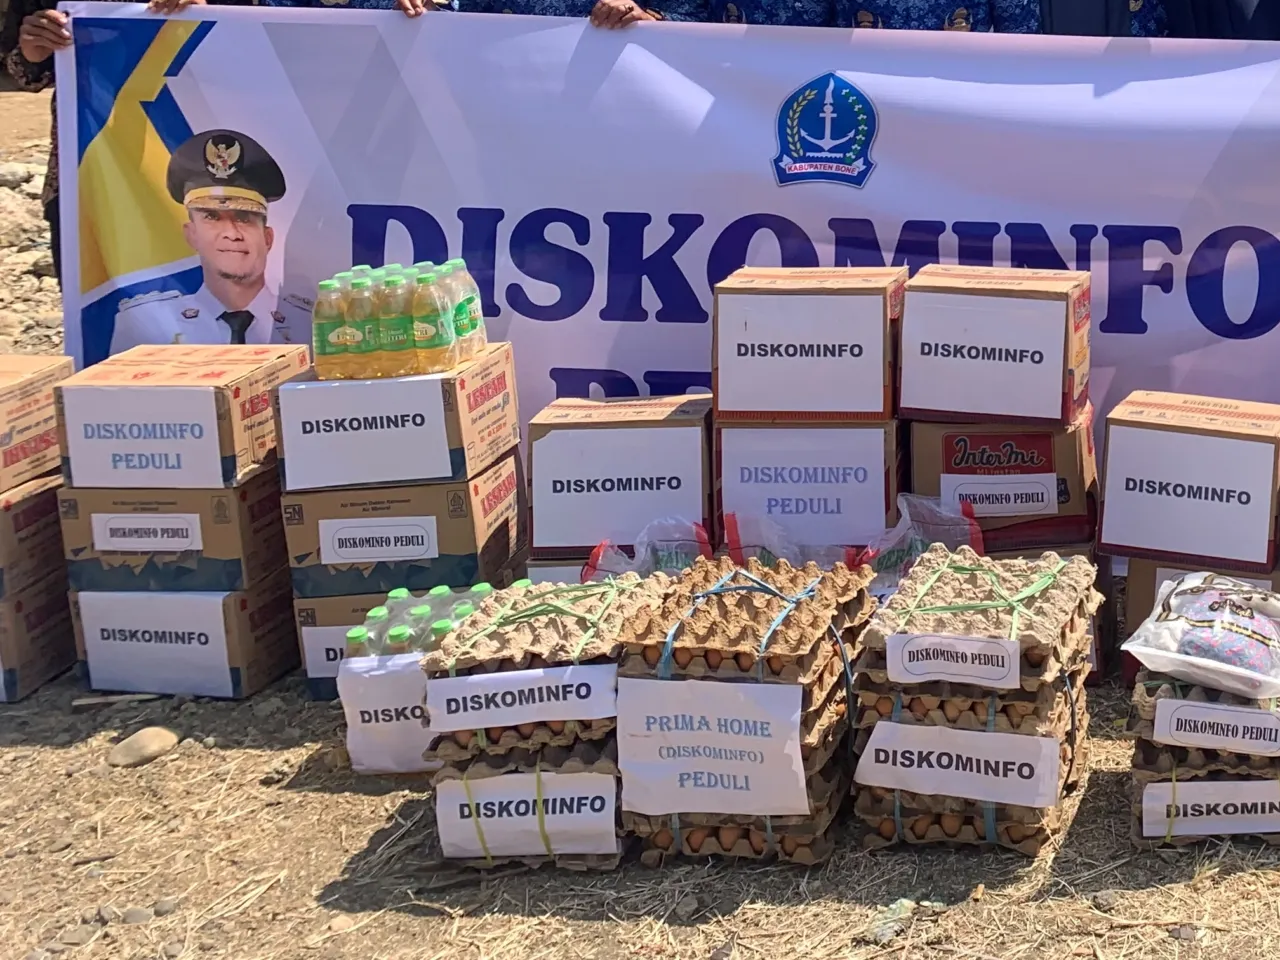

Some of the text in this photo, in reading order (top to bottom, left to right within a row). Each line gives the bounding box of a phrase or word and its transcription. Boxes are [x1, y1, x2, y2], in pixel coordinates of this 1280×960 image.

[787, 164, 857, 174] KABUPATEN BONE
[737, 343, 863, 357] DISKOMINFO
[921, 342, 1043, 364] DISKOMINFO
[84, 423, 203, 439] DISKOMINFO
[302, 414, 425, 434] DISKOMINFO
[112, 453, 181, 469] PEDULI
[553, 476, 681, 493] DISKOMINFO
[740, 467, 868, 483] DISKOMINFO
[1014, 492, 1044, 503] PEDULI
[1125, 478, 1250, 505] DISKOMINFO
[767, 498, 842, 514] PEDULI
[109, 528, 189, 538] DISKOMINFO PEDULI
[338, 535, 424, 548] DISKOMINFO PEDULI
[100, 628, 209, 645] DISKOMINFO
[908, 648, 1004, 668] DISKOMINFO PEDULI
[446, 683, 591, 714] DISKOMINFO
[360, 705, 425, 724] DISKO
[646, 714, 772, 737] PRIMA HOME
[1176, 718, 1278, 742] DISKOMINFO PEDULI
[659, 745, 764, 764] (DISKOMINFO)
[875, 749, 1034, 779] DISKOMINFO
[678, 772, 750, 791] PEDULI
[459, 795, 605, 820] DISKOMINFO
